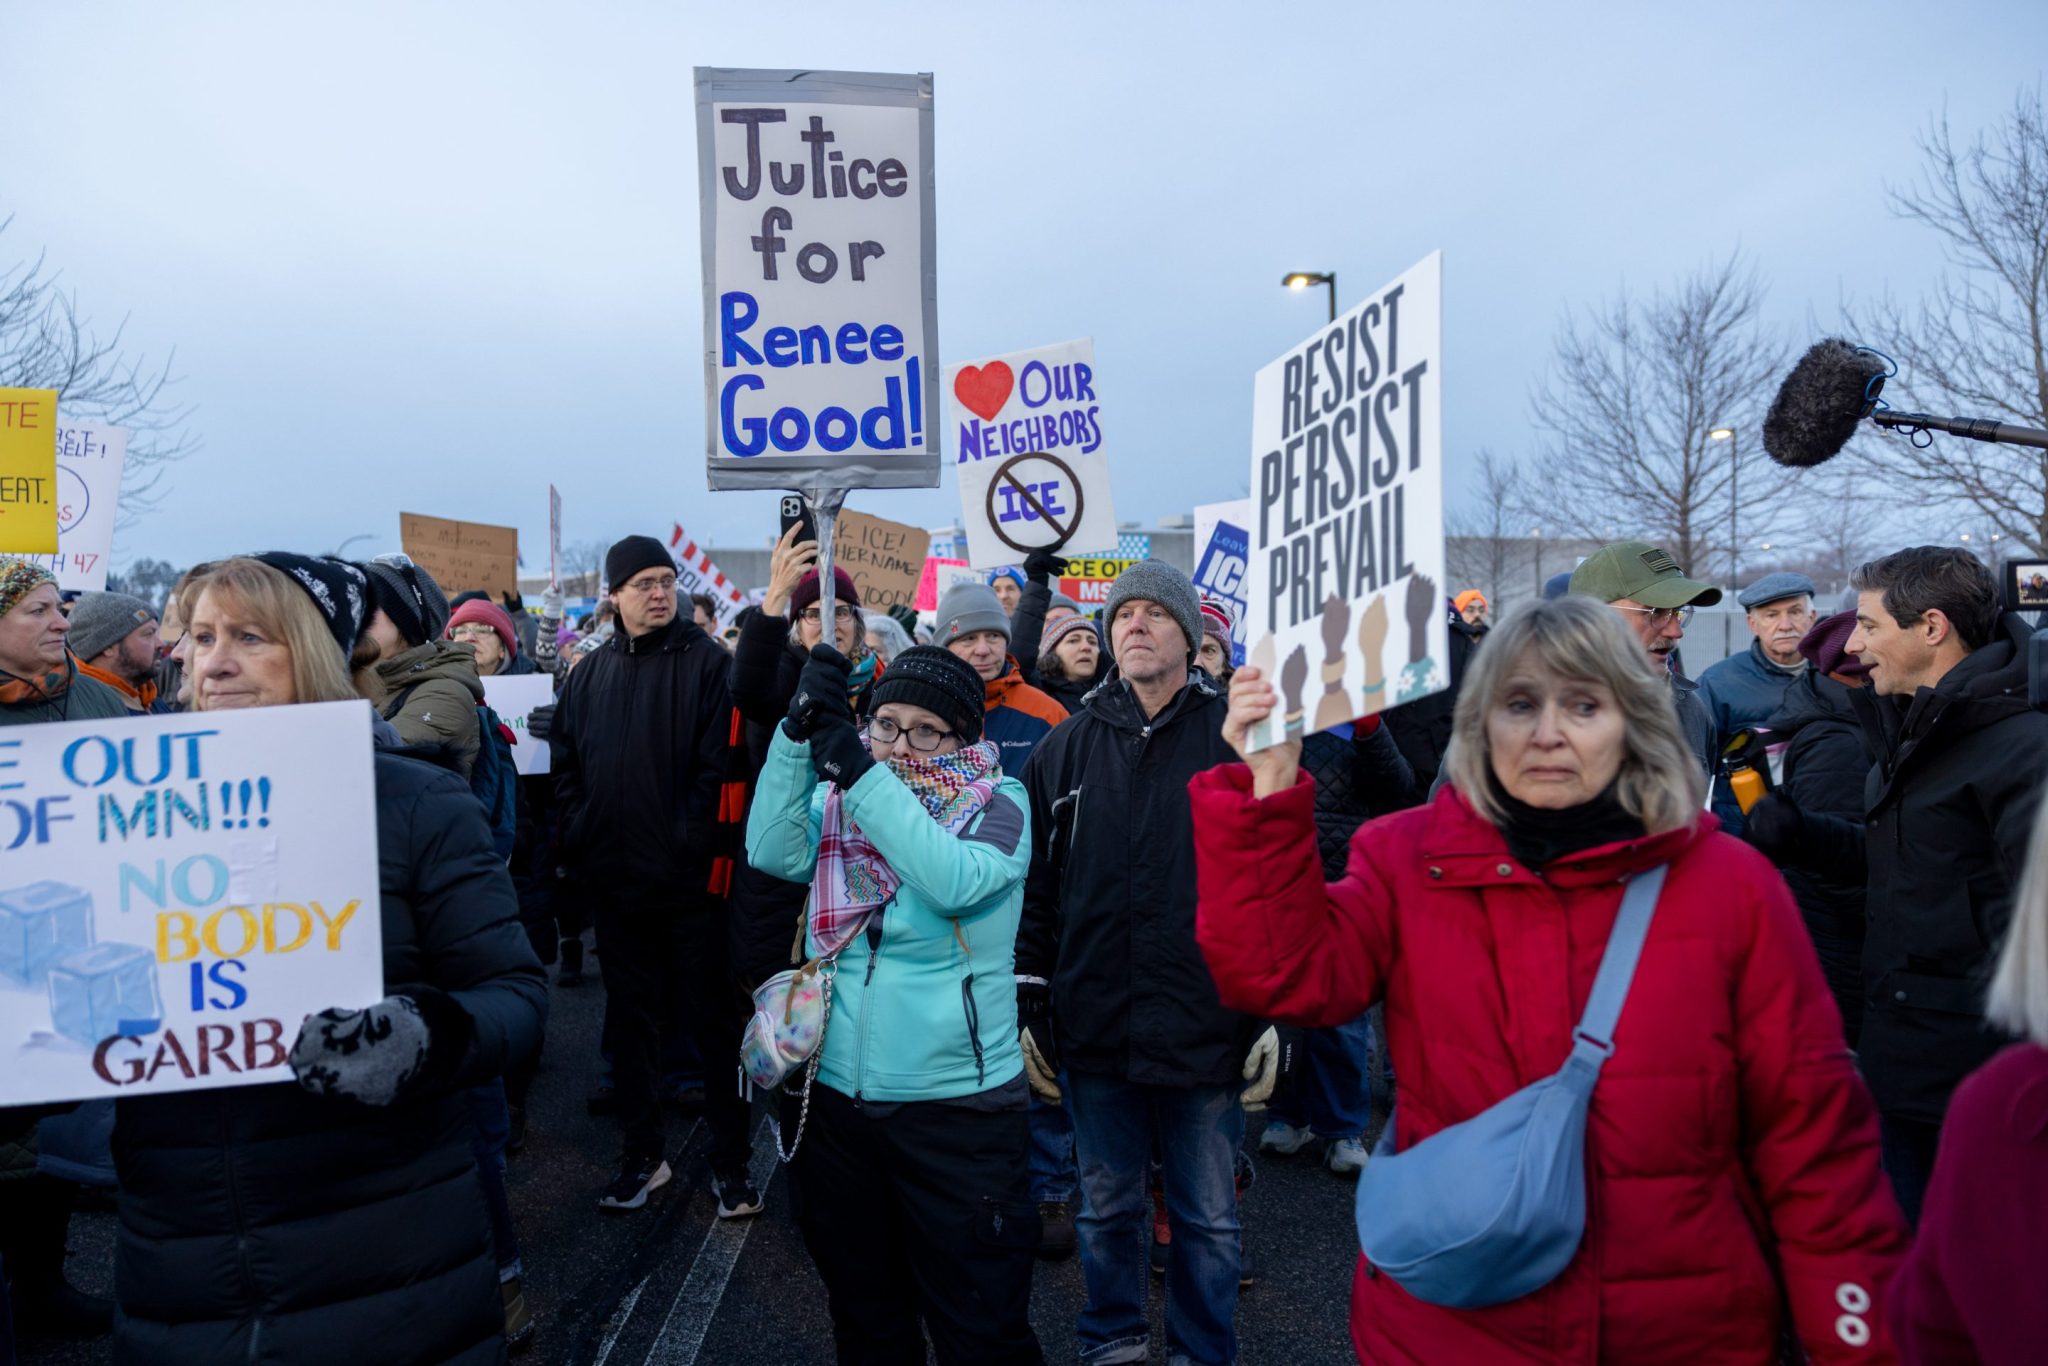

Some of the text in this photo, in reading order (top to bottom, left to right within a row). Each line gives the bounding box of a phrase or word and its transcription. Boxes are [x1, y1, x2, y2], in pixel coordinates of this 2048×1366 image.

[720, 108, 908, 201] Jutice
[751, 206, 885, 283] for
[720, 291, 904, 368] Renee
[1019, 360, 1096, 408] OUR
[1283, 283, 1404, 441] RESIST
[720, 355, 923, 457] Good!
[958, 406, 1102, 464] NEIGHBORS
[1259, 359, 1427, 550] PERSIST
[998, 480, 1066, 523] ICE
[74, 553, 99, 574] 47
[862, 525, 906, 553] ICE!
[1067, 560, 1097, 577] CE
[1213, 530, 1248, 554] Leav
[1268, 483, 1415, 634] PREVAIL
[61, 730, 220, 788] OUT
[98, 776, 273, 843] MN!!!
[119, 853, 229, 912] NO
[155, 900, 361, 963] BODY
[190, 959, 247, 1012] IS
[91, 1017, 292, 1087] GARB
